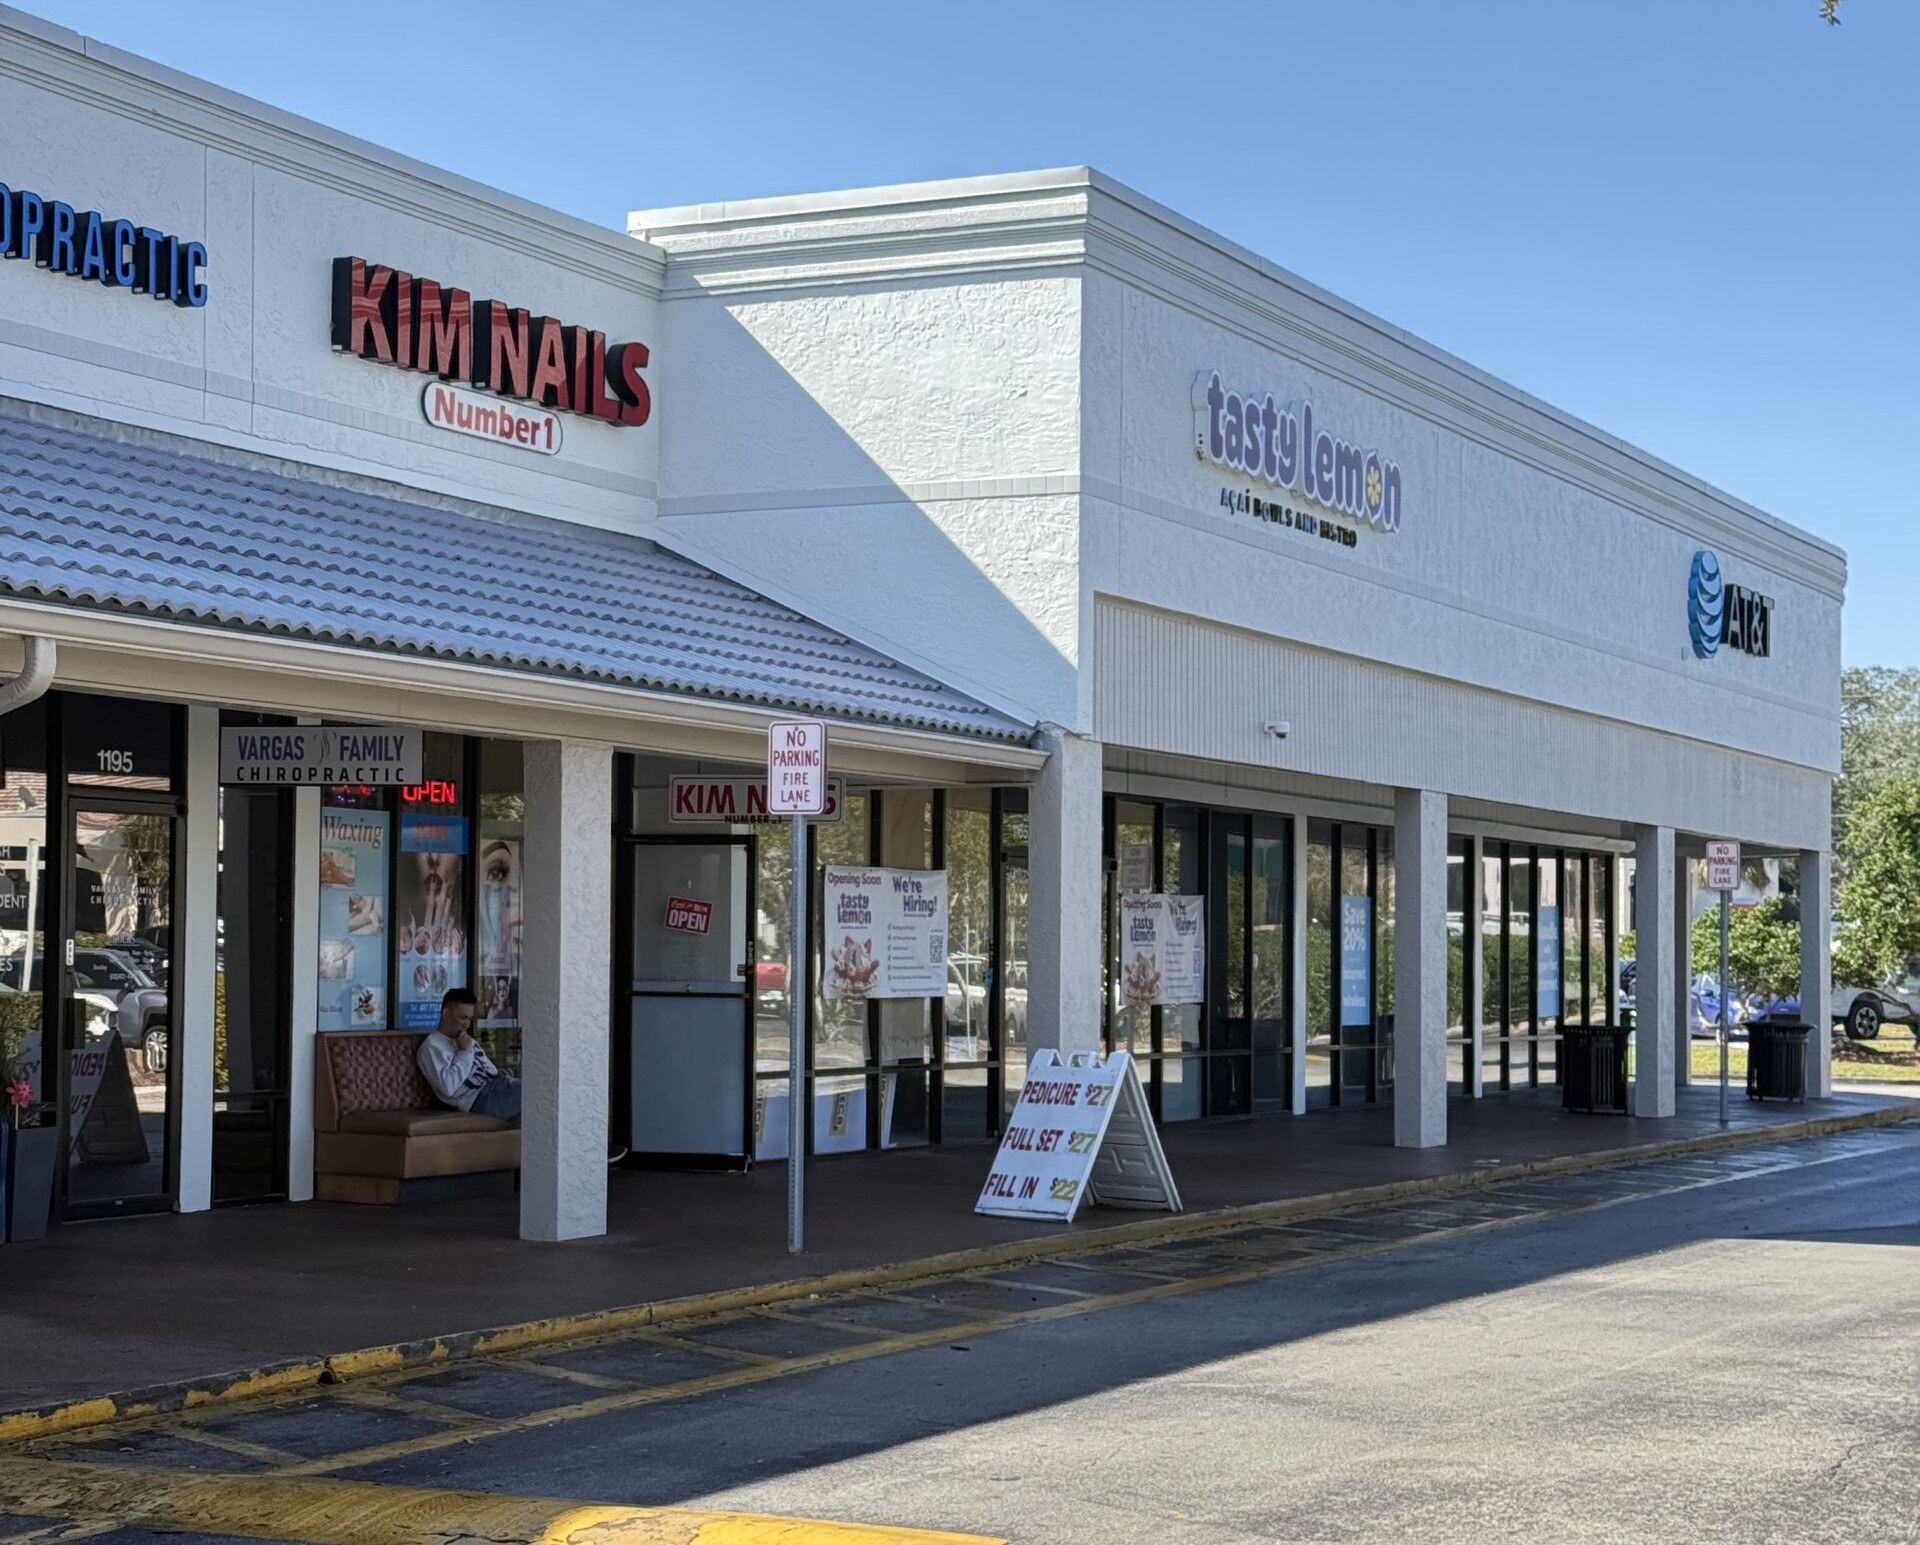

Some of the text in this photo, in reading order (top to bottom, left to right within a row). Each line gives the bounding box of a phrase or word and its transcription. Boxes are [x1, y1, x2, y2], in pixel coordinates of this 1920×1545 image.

[348, 256, 651, 427] KIM NAILS
[1207, 371, 1401, 532] tasty lemon
[1252, 498, 1293, 529] BOWLS
[1294, 511, 1318, 536] AND
[1319, 520, 1358, 549] BISTRO
[1723, 584, 1775, 657] AT&T
[237, 735, 405, 761] VARGAS FAMILY
[786, 730, 806, 747] NO
[97, 749, 133, 773] 1195
[773, 750, 819, 767] PARKING
[236, 766, 405, 783] CHIROPRACTIC
[782, 772, 809, 786] FIRE
[402, 780, 457, 804] OPEN
[676, 784, 736, 814] KIM
[780, 789, 811, 803] LANE
[724, 814, 769, 824] NUMBER
[323, 814, 384, 848] Waxing
[1707, 856, 1737, 865] PARKING
[1716, 846, 1729, 855] NO
[827, 872, 882, 888] Opening Soon
[892, 876, 922, 894] We're
[1714, 877, 1732, 885] LANE
[840, 893, 870, 910] tasty
[902, 895, 938, 918] Hiring!
[668, 909, 707, 931] OPEN
[837, 903, 872, 924] lemon
[1132, 915, 1155, 930] tasty
[1344, 902, 1366, 925] Save
[1343, 926, 1366, 952] 20%
[1020, 1080, 1114, 1106] PEDICURE $27
[1002, 1127, 1098, 1154] FULL SET $27
[983, 1173, 1080, 1200] FILL IN $22
